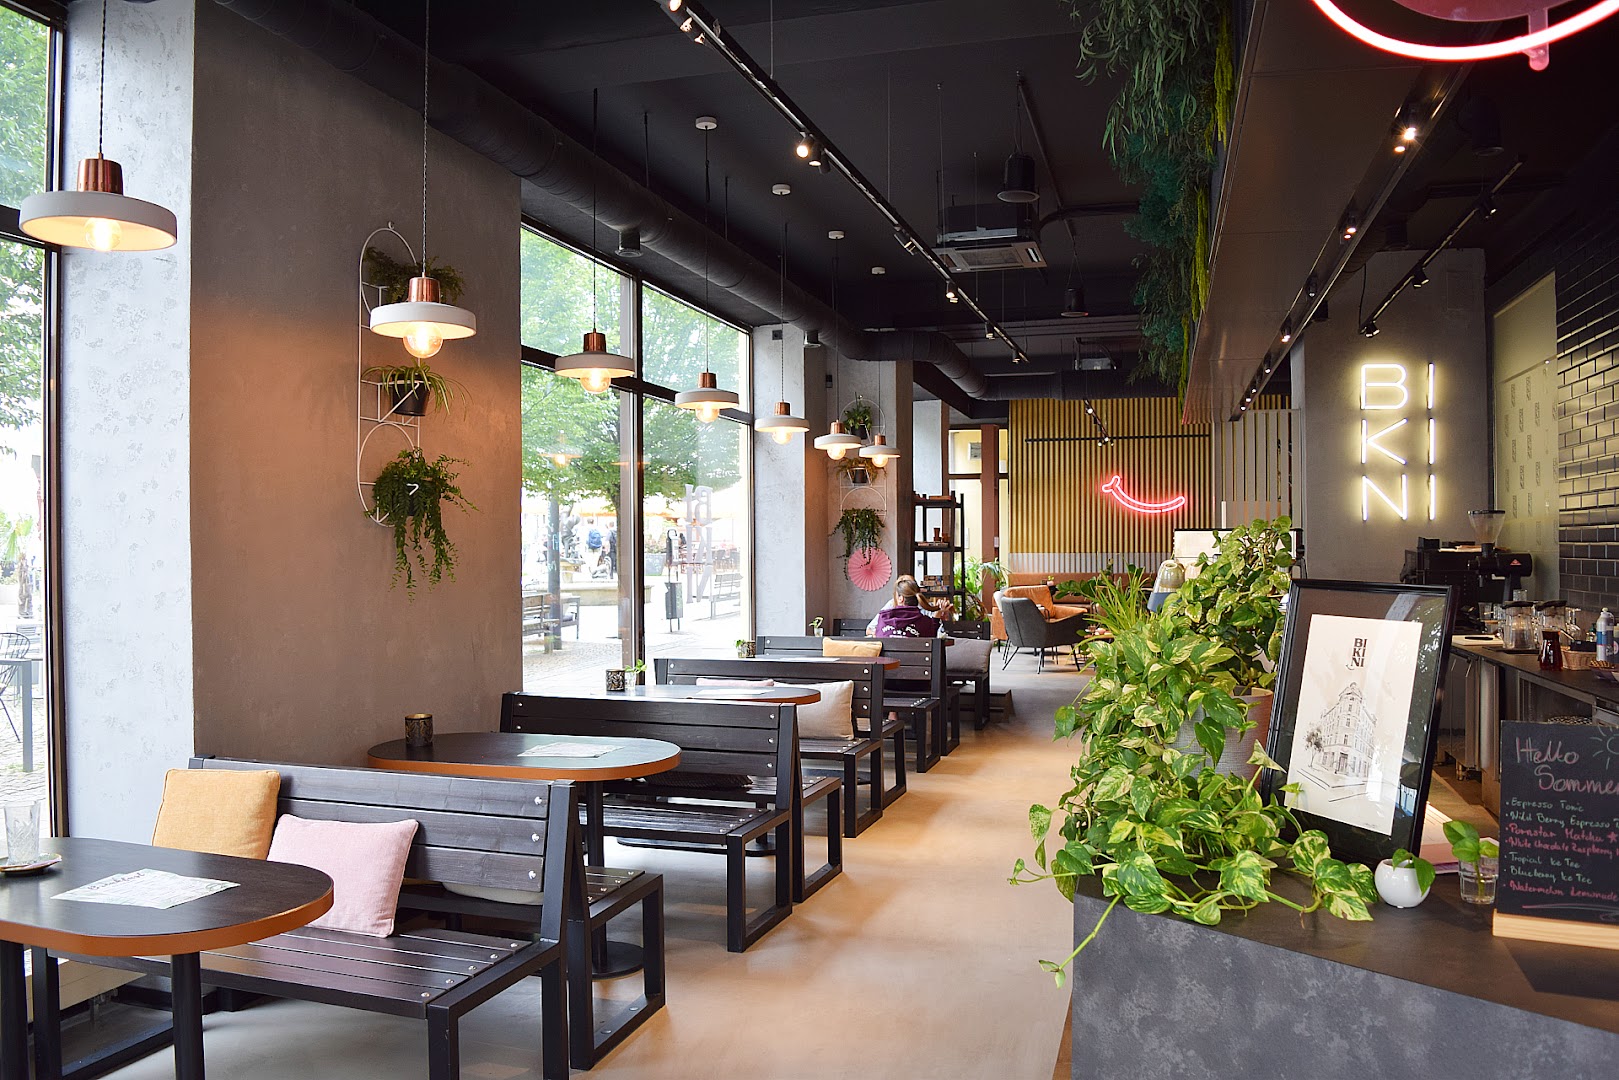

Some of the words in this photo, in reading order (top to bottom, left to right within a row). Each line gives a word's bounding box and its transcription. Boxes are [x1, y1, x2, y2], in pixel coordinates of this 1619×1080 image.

[1360, 363, 1435, 410] BI
[1361, 417, 1436, 465] KI
[1361, 474, 1436, 521] NI
[905, 626, 920, 637] FOX
[1352, 648, 1366, 657] KI
[1354, 638, 1368, 648] BI
[1351, 657, 1364, 667] NI
[1515, 737, 1580, 764] Hello
[1511, 797, 1553, 809] Espresso
[1560, 800, 1584, 812] Tonic
[1510, 811, 1532, 821] Wild
[1536, 813, 1565, 828] Berry
[1570, 815, 1610, 829] Espresso
[1509, 823, 1556, 837] Pornstar
[1565, 828, 1604, 842] Matcha
[1508, 837, 1531, 848] White
[1572, 843, 1613, 859] Raspberry
[1509, 851, 1542, 864] Tropical
[1564, 858, 1580, 869] Tee
[1510, 865, 1556, 883] Blueberry
[1575, 873, 1592, 884] Tee
[1509, 880, 1565, 896] Watermelon
[1570, 886, 1618, 902] Lemonade
